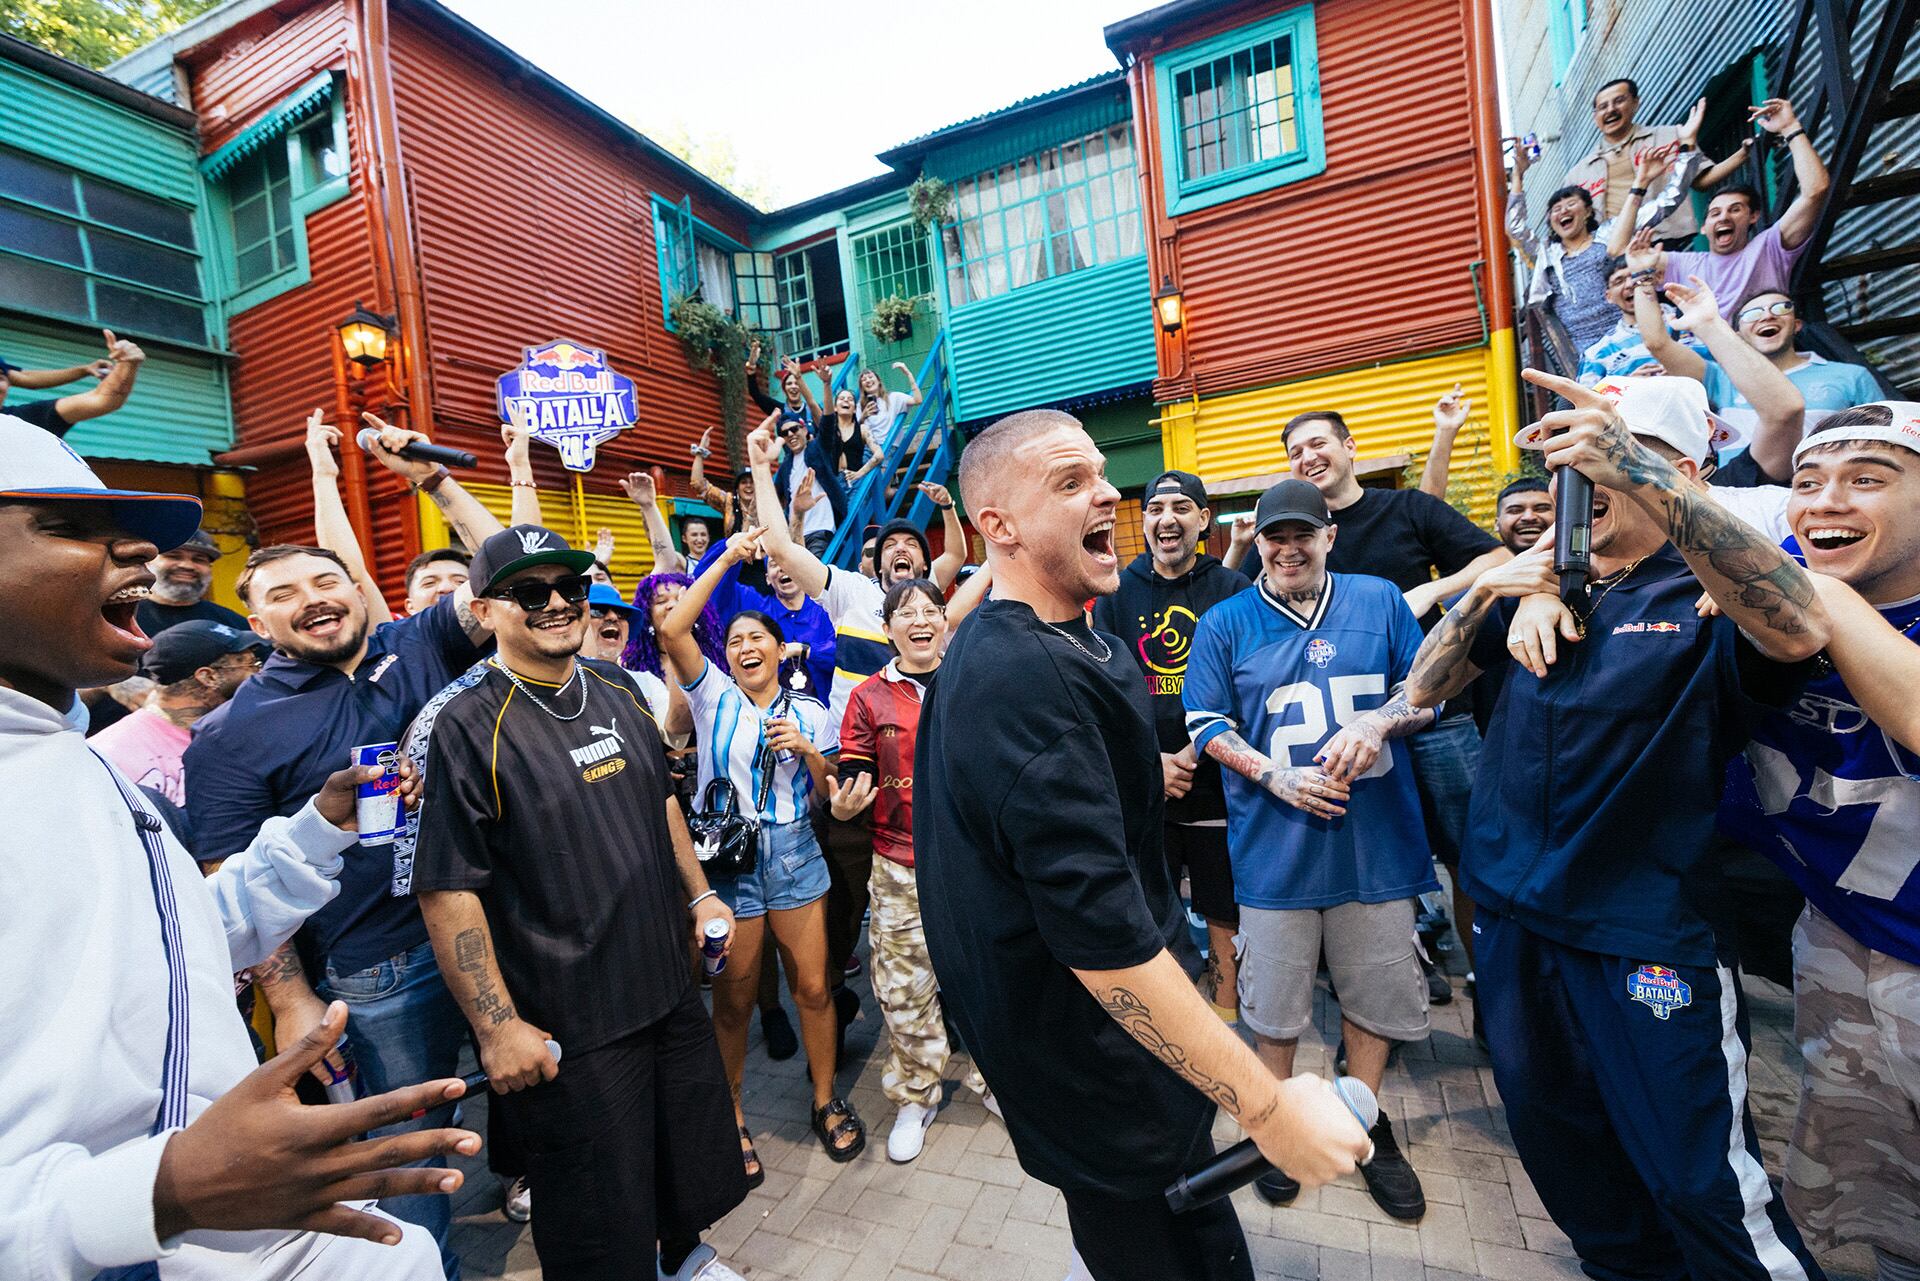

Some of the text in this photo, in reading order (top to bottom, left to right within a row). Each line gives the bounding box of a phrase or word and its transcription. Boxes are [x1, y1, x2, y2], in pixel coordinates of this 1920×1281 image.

[524, 371, 611, 391] Red Bull
[518, 394, 623, 433] BATALLA
[1265, 673, 1394, 781] 25
[569, 736, 622, 767] PUMA
[590, 761, 616, 780] KING
[373, 777, 400, 790] Red
[1639, 974, 1678, 988] Red Bull
[1636, 985, 1683, 1003] BATALLA
